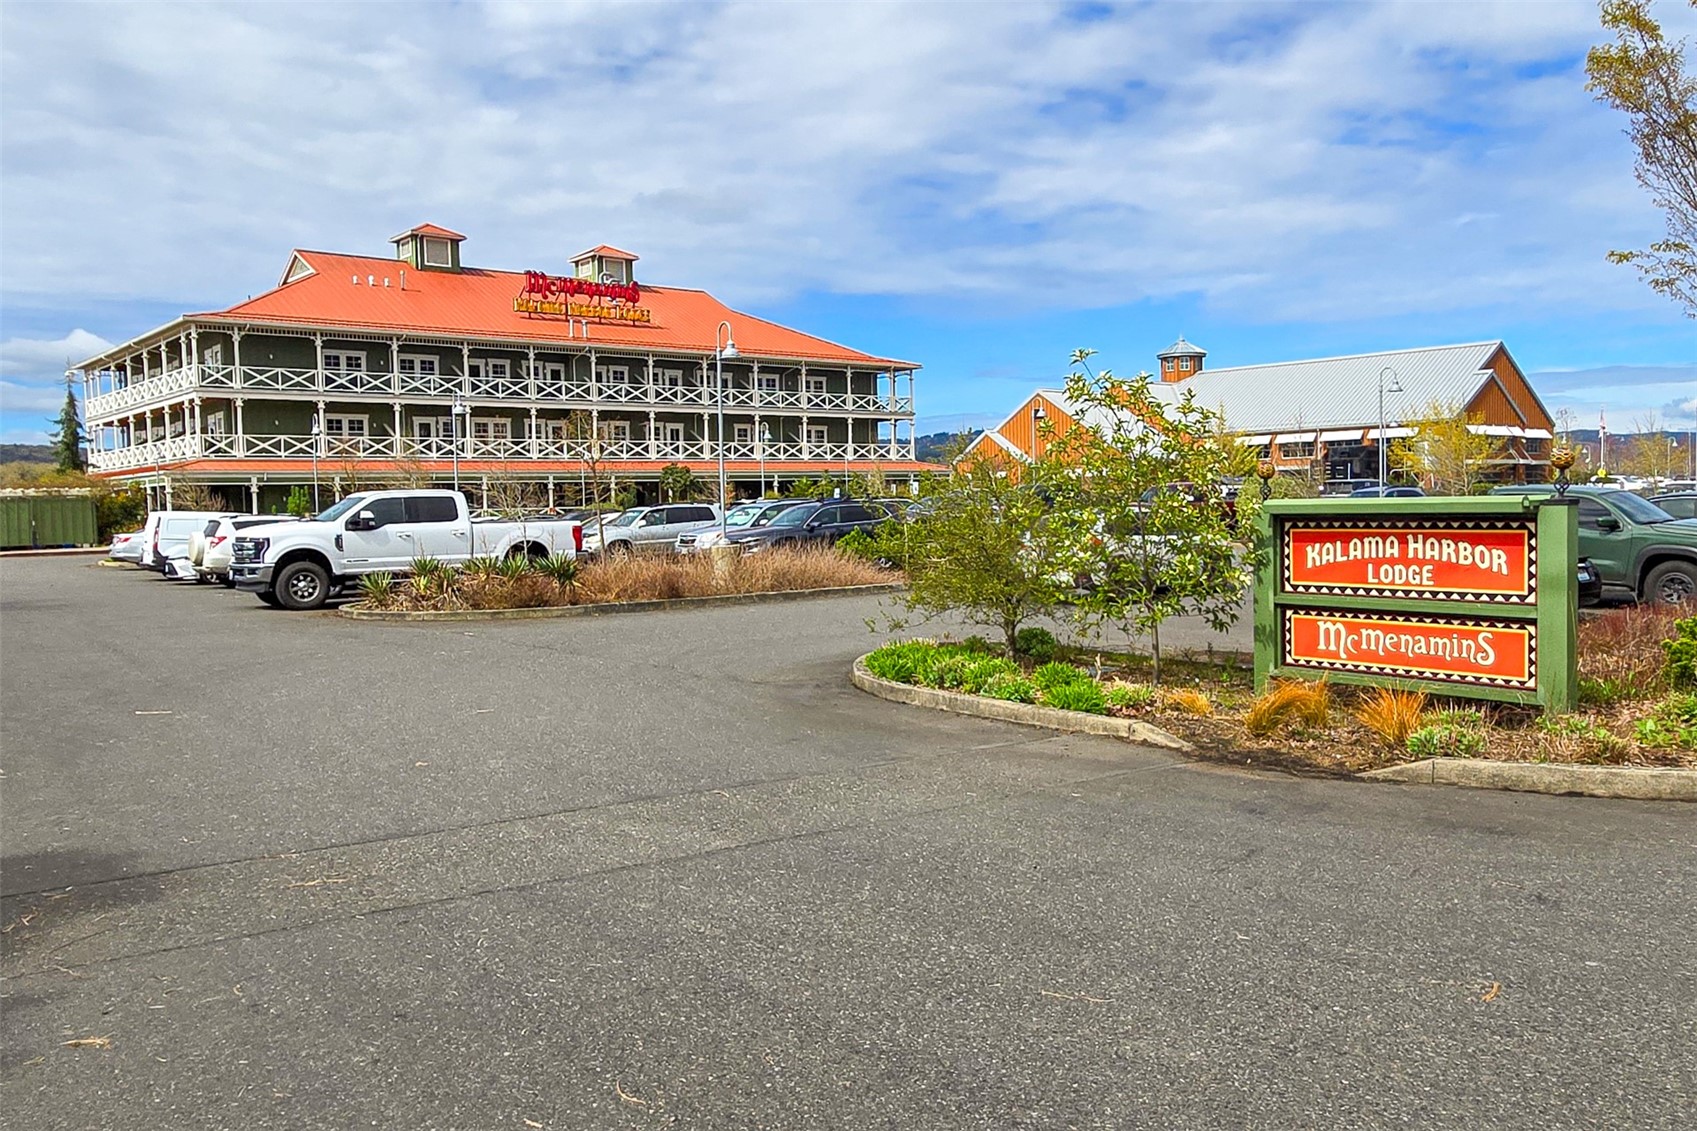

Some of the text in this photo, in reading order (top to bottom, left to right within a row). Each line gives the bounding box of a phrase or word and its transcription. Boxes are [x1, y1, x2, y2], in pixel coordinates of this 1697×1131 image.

[1306, 534, 1508, 576] KALAMA HARBOR
[1367, 563, 1434, 586] LODGE
